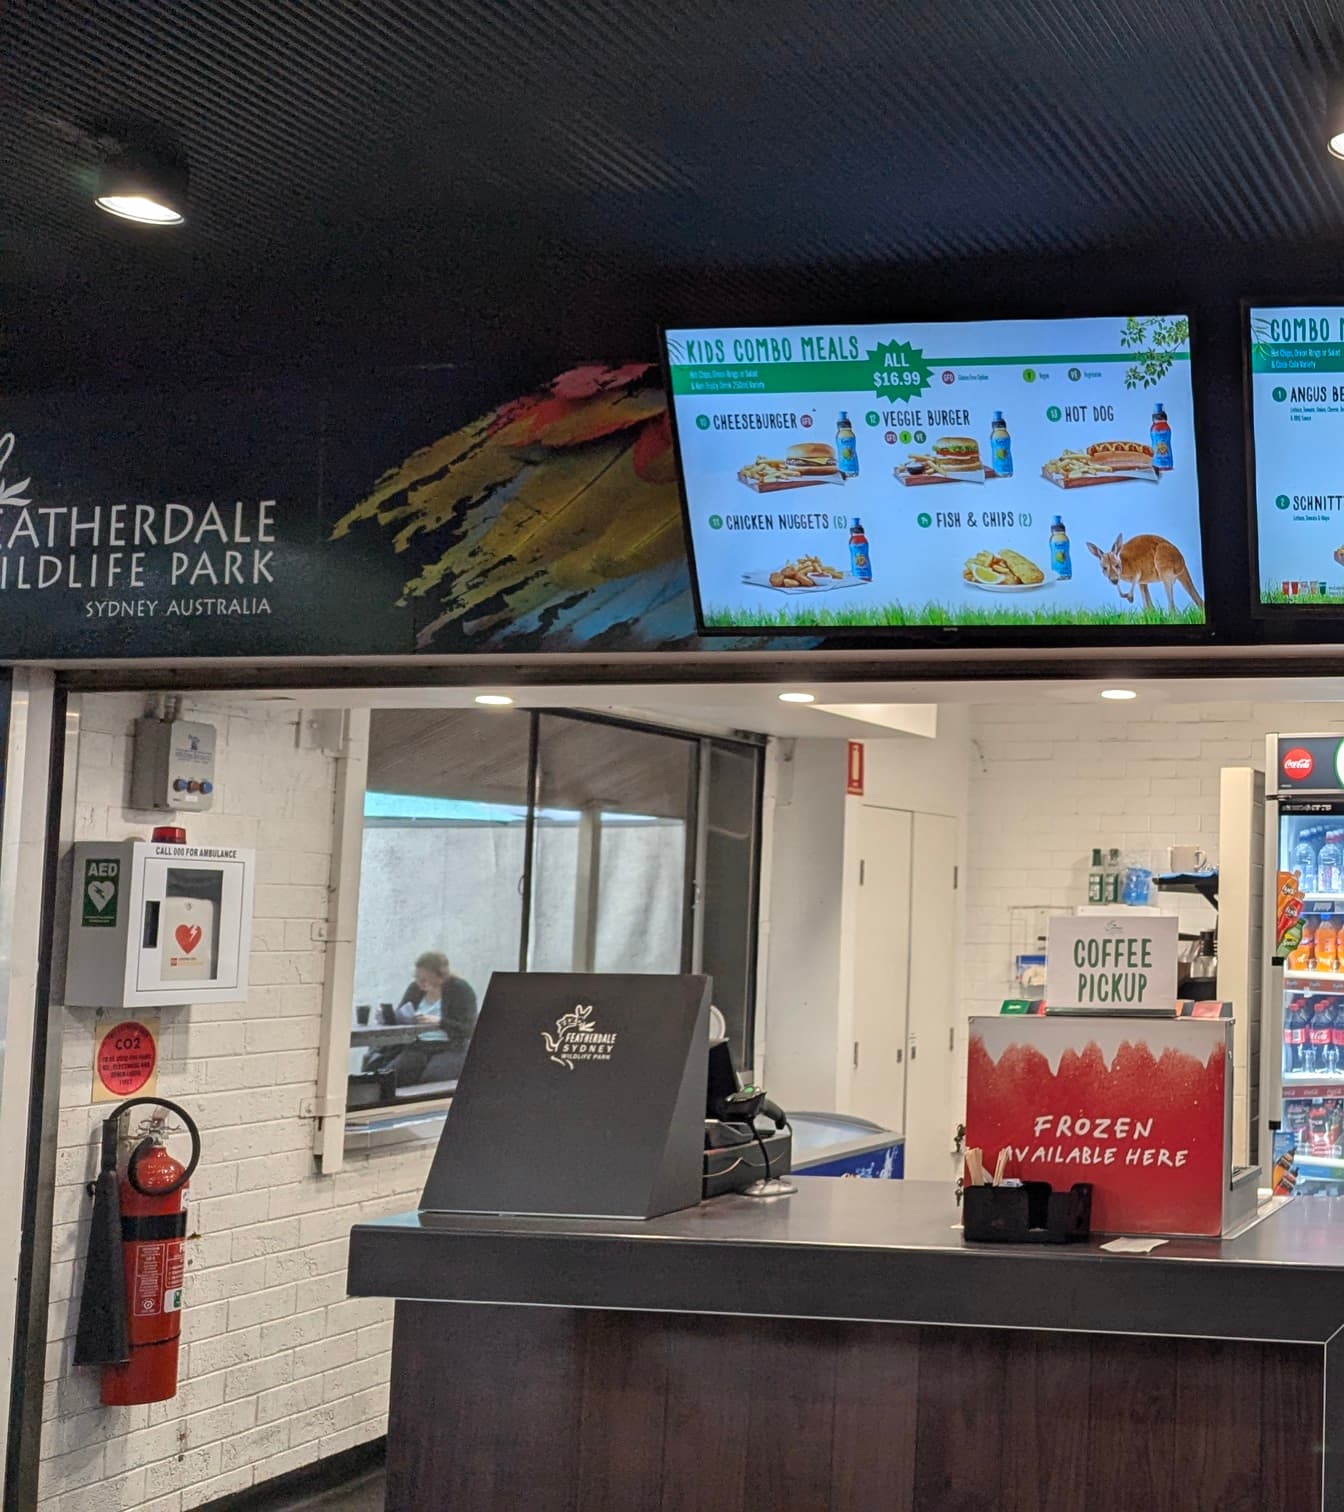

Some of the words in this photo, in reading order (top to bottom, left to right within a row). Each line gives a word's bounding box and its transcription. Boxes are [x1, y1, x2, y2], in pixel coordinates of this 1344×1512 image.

[1270, 318, 1330, 342] COMBO
[686, 339, 724, 363] KIDS
[733, 338, 792, 362] COMBO
[801, 335, 859, 361] MEALS
[884, 353, 909, 367] ALL
[873, 372, 921, 387] $16.99
[1290, 387, 1327, 402] ANGUS
[713, 413, 798, 430] CHEESEBURGER
[882, 410, 923, 427] VEGGIE
[927, 409, 971, 426] BURGER
[1065, 406, 1090, 423] HOT
[1093, 405, 1115, 422] DOG
[0, 500, 276, 550] ATHERDALE
[726, 514, 774, 531] CHICKEN
[779, 513, 830, 530] NUGGETS
[833, 514, 847, 530] (6)
[936, 512, 961, 528] FISH
[967, 513, 977, 528] &
[982, 512, 1015, 527] CHIPS
[1018, 512, 1032, 528] (2)
[171, 549, 274, 586] PARK
[85, 600, 158, 618] SYDNEY
[166, 598, 272, 616] AUSTRALIA
[1284, 758, 1312, 769] Coca-Cola
[156, 847, 172, 856] CALL
[186, 848, 198, 857] FOR
[199, 848, 237, 858] AMBULANCE
[88, 862, 118, 876] AED
[1073, 938, 1153, 969] COFFEE
[1077, 972, 1148, 1003] PICKUP
[115, 1037, 141, 1050] CO2
[565, 1032, 617, 1044] FEATHERDALE
[562, 1044, 613, 1053] SYDNEY
[1033, 1115, 1153, 1140] FROZEN
[1000, 1145, 1118, 1165] AVAILABLE
[1125, 1148, 1189, 1168] HERE
